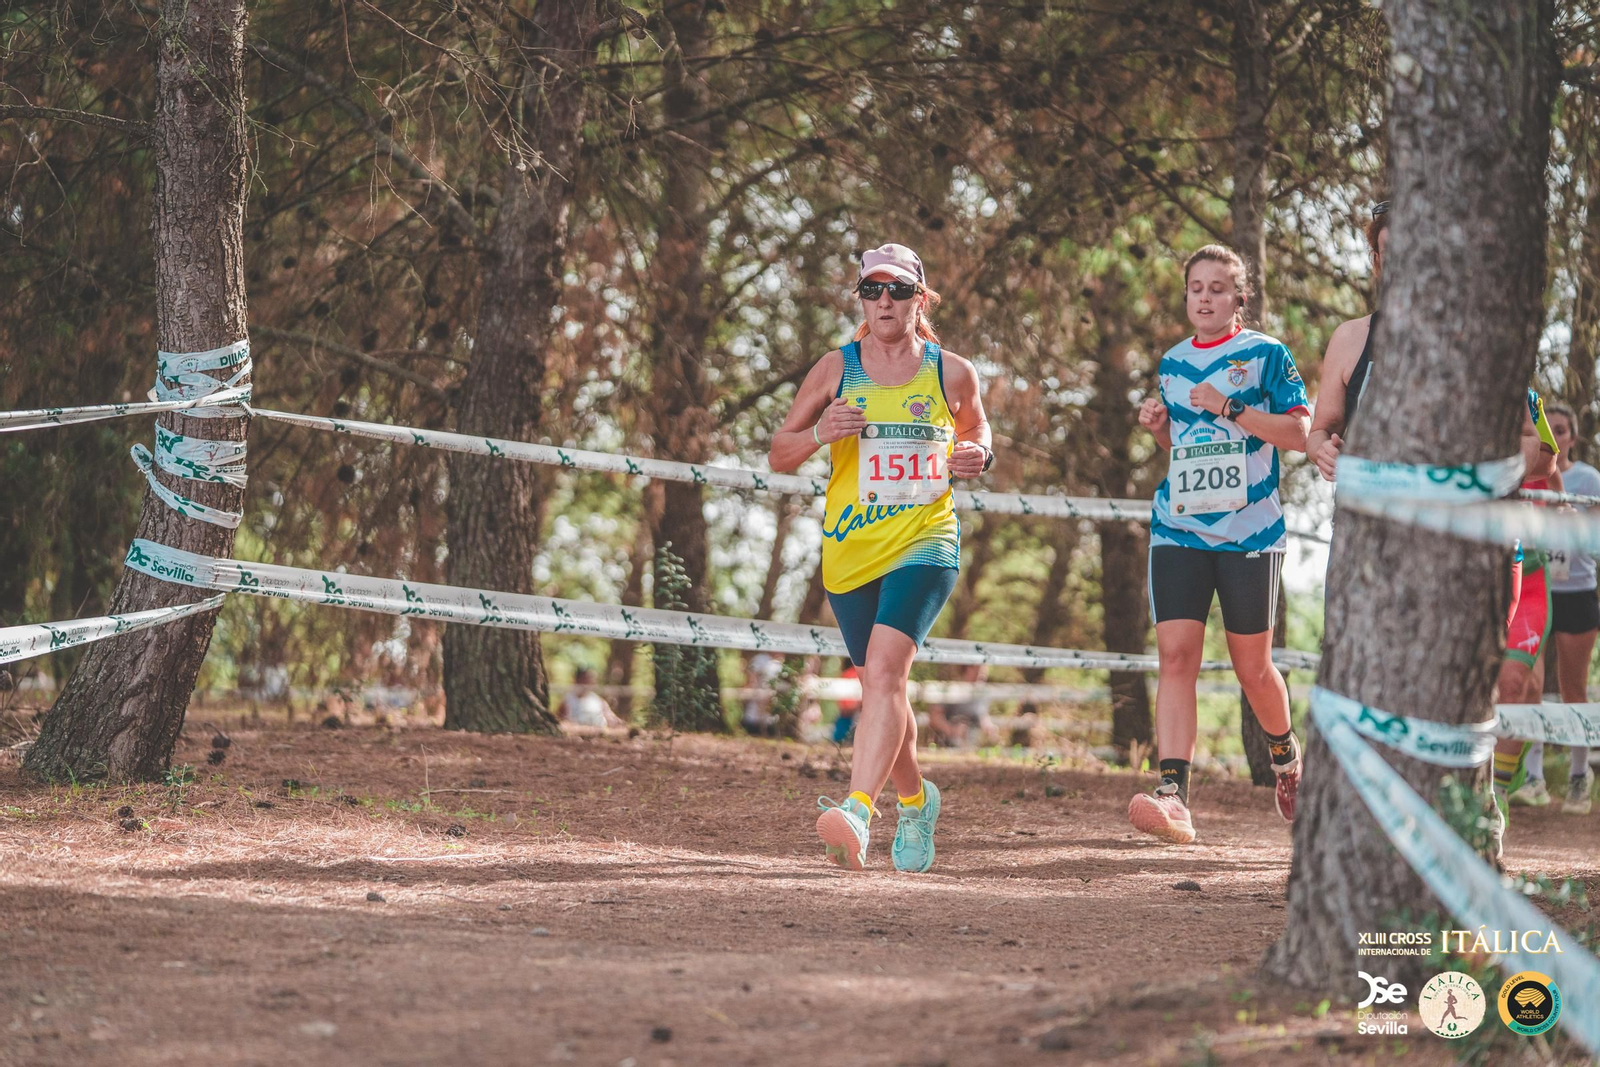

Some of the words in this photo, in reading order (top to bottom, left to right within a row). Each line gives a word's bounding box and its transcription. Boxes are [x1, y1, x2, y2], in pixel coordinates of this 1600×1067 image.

[884, 425, 927, 437] ITÁLICA
[1190, 444, 1225, 457] ITÁLICA
[868, 453, 942, 481] 1511
[1178, 465, 1242, 494] 1208
[151, 561, 195, 583] Sevilla
